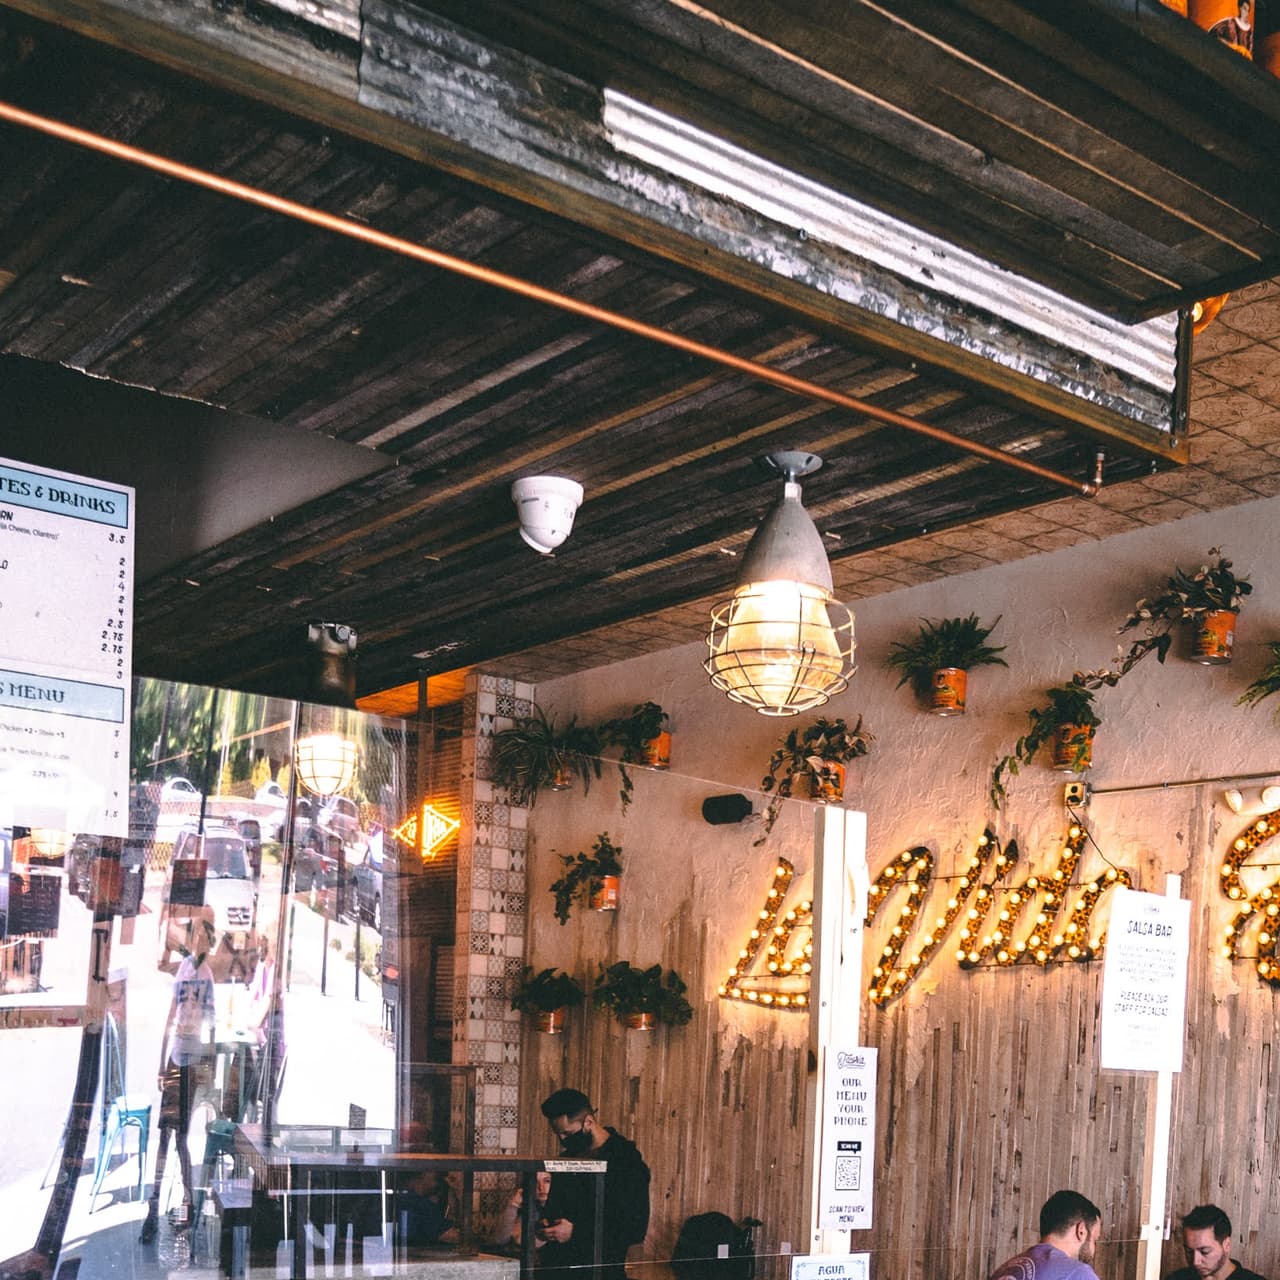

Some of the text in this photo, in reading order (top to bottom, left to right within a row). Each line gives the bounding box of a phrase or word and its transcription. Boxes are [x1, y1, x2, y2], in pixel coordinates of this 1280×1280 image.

[35, 485, 44, 500] &
[48, 488, 117, 516] DRINKS
[9, 682, 66, 705] MENU
[1126, 920, 1174, 938] SALSA BAR
[841, 1077, 862, 1088] OUR
[836, 1090, 867, 1102] MENU
[838, 1103, 865, 1114] YOUR
